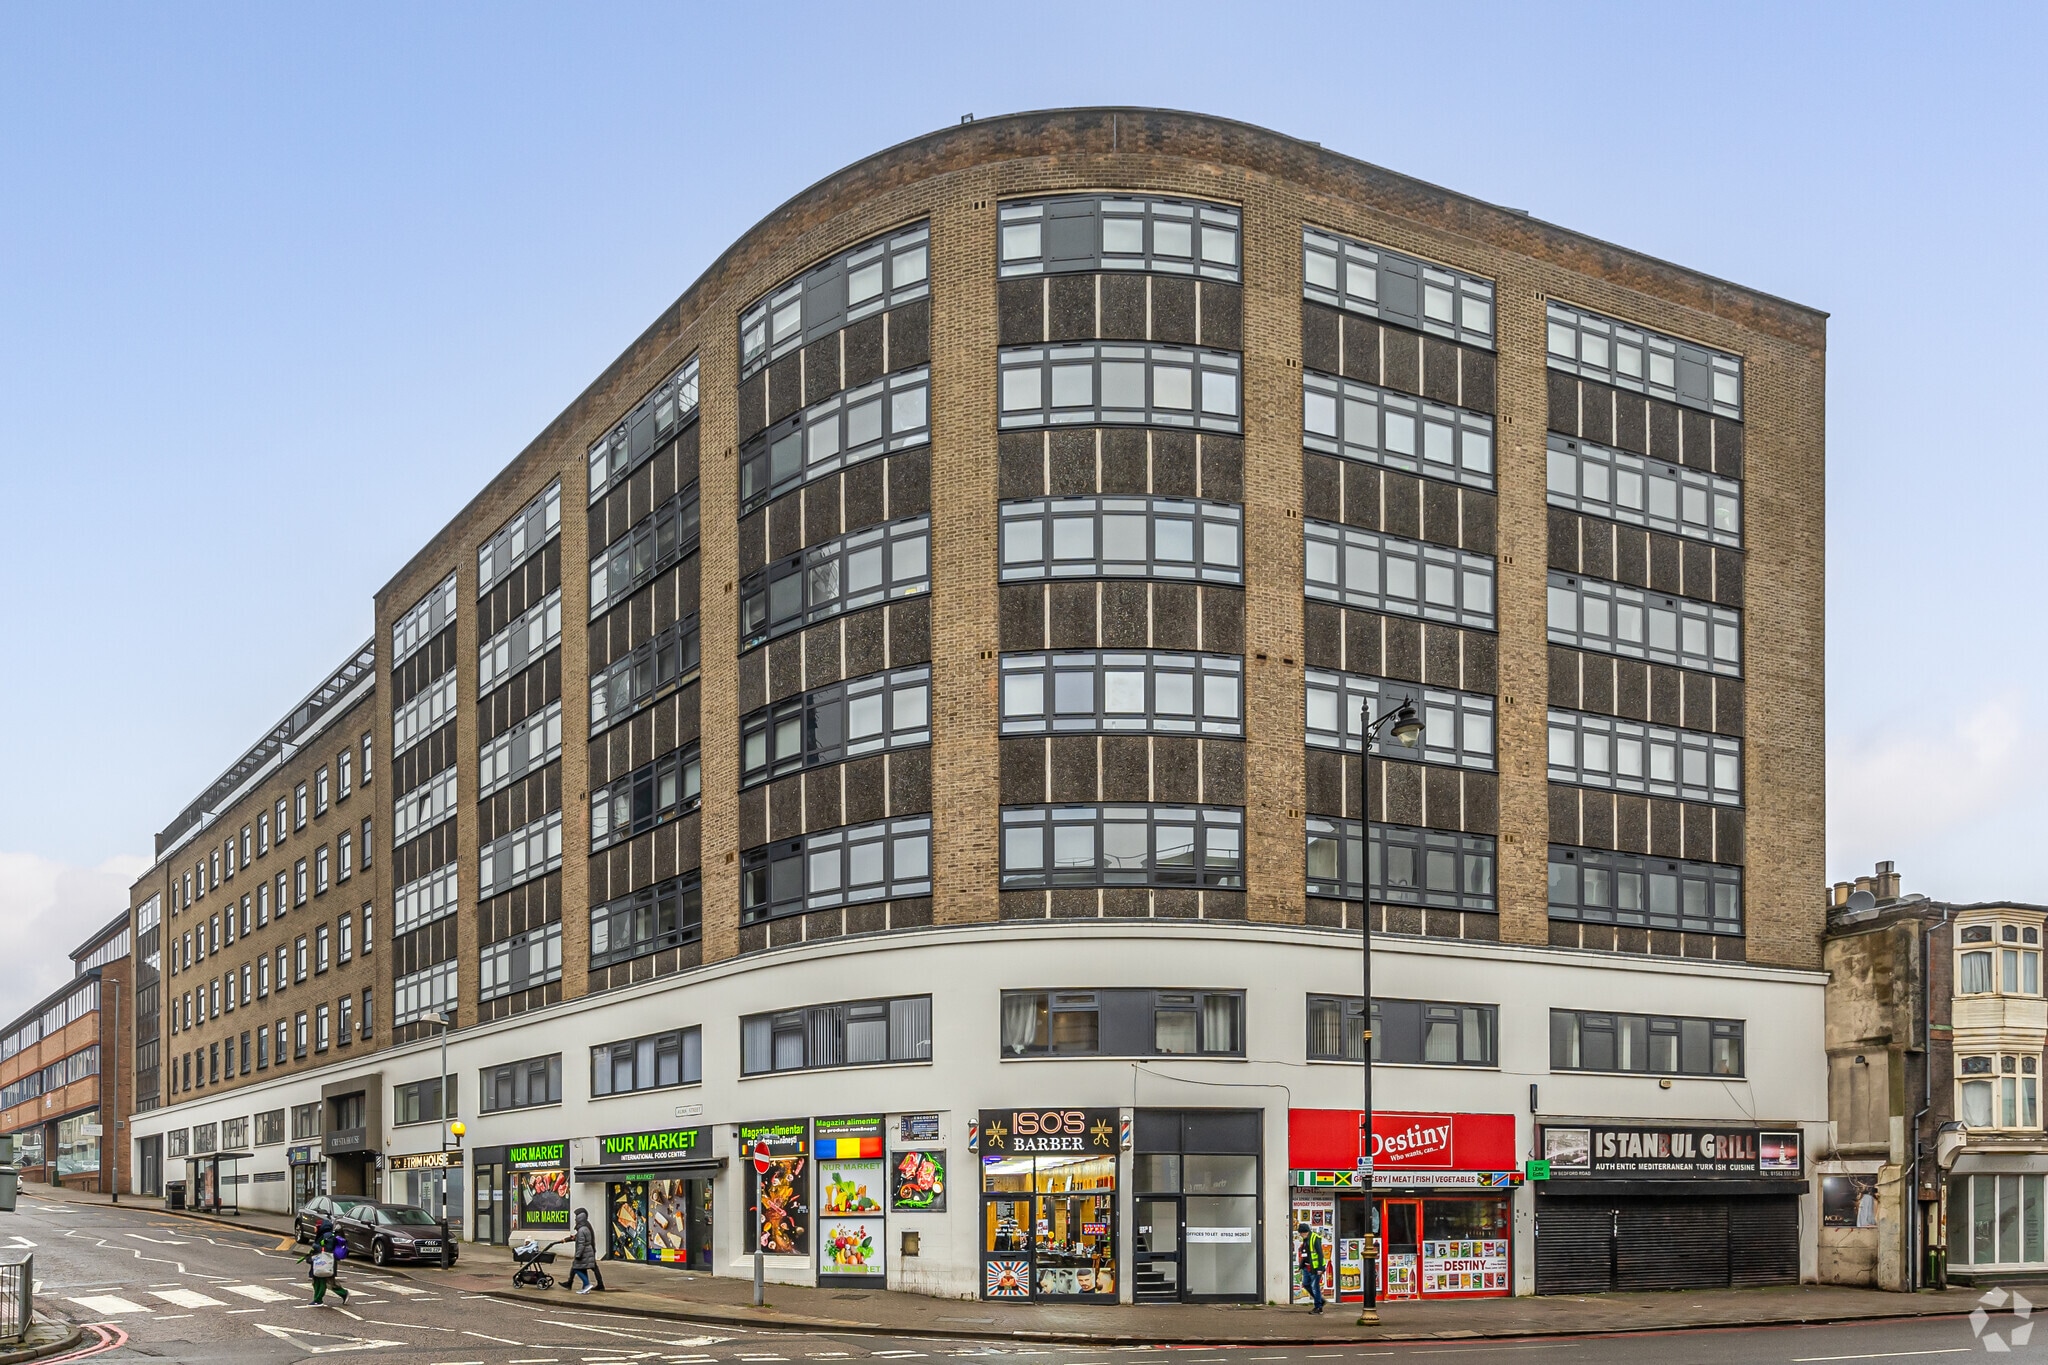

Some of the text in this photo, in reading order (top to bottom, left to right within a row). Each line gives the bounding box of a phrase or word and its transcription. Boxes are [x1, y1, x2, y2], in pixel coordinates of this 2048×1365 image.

[816, 1117, 880, 1127] Magazin alimentar
[1012, 1110, 1085, 1135] ISO'S
[770, 1124, 805, 1136] alimentar
[606, 1136, 635, 1153] NUR
[638, 1130, 698, 1151] MARKET
[1013, 1137, 1085, 1151] BARBER
[1595, 1132, 1757, 1160] ISTANBUL GRILL
[510, 1144, 565, 1162] NUR MARKET
[620, 1153, 654, 1161] INTERNATIONAL
[667, 1150, 687, 1158] CENTRE
[1390, 1153, 1404, 1162] Who
[407, 1156, 423, 1169] TRIM
[822, 1162, 881, 1172] NUR MARKET
[1638, 1163, 1693, 1171] MEDITERRANEAN
[1392, 1175, 1412, 1183] MEAT
[1415, 1175, 1431, 1183] FISH
[1435, 1175, 1476, 1184] VEGETABLES
[526, 1210, 569, 1223] NUR MARKET
[822, 1265, 881, 1273] NUR MARKET
[1443, 1260, 1487, 1272] DESTINY
